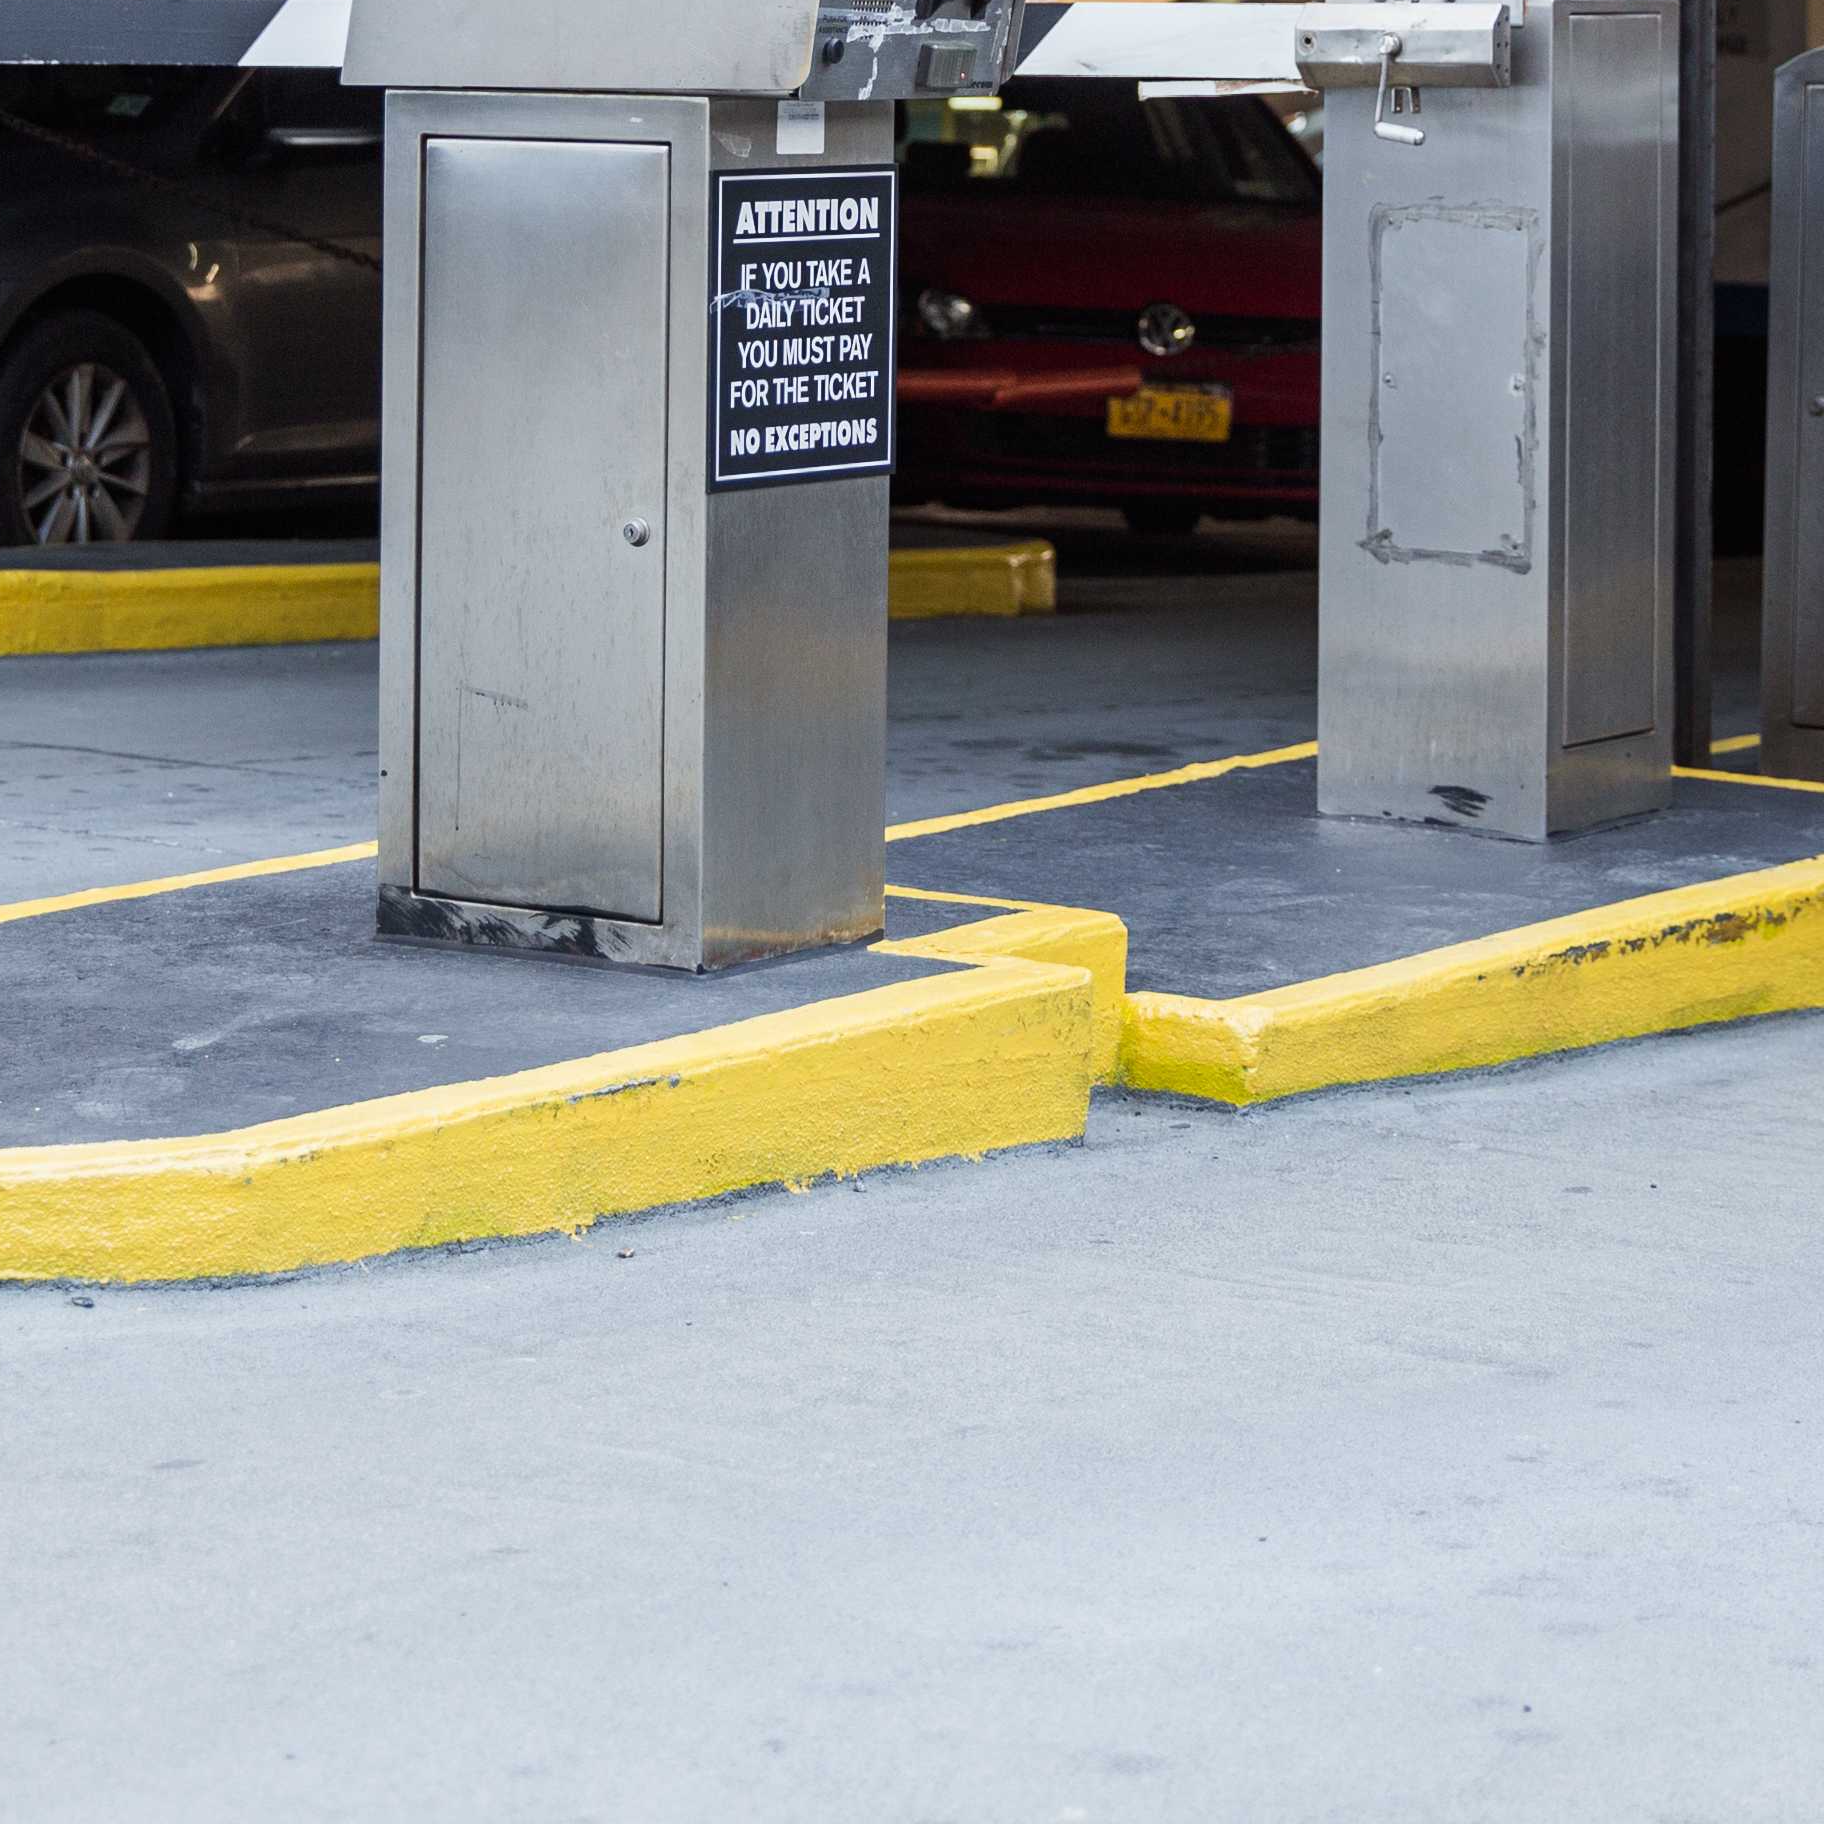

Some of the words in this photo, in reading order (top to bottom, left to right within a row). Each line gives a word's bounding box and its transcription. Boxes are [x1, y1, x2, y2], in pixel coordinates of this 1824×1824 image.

[735, 197, 879, 235] ATTENTION
[741, 263, 757, 290] IF
[762, 261, 802, 290] YOU
[807, 258, 853, 287] TAKE
[857, 258, 871, 284] A
[746, 301, 797, 329] DAILY
[799, 296, 866, 325] TICKET
[738, 340, 778, 368] YOU
[783, 336, 835, 365] MUST
[839, 333, 873, 361] PAY
[730, 379, 769, 408] FOR
[773, 375, 809, 404] THE
[814, 371, 879, 401] TICKET
[730, 429, 760, 456] NO
[765, 418, 878, 453] EXCEPTIONS
